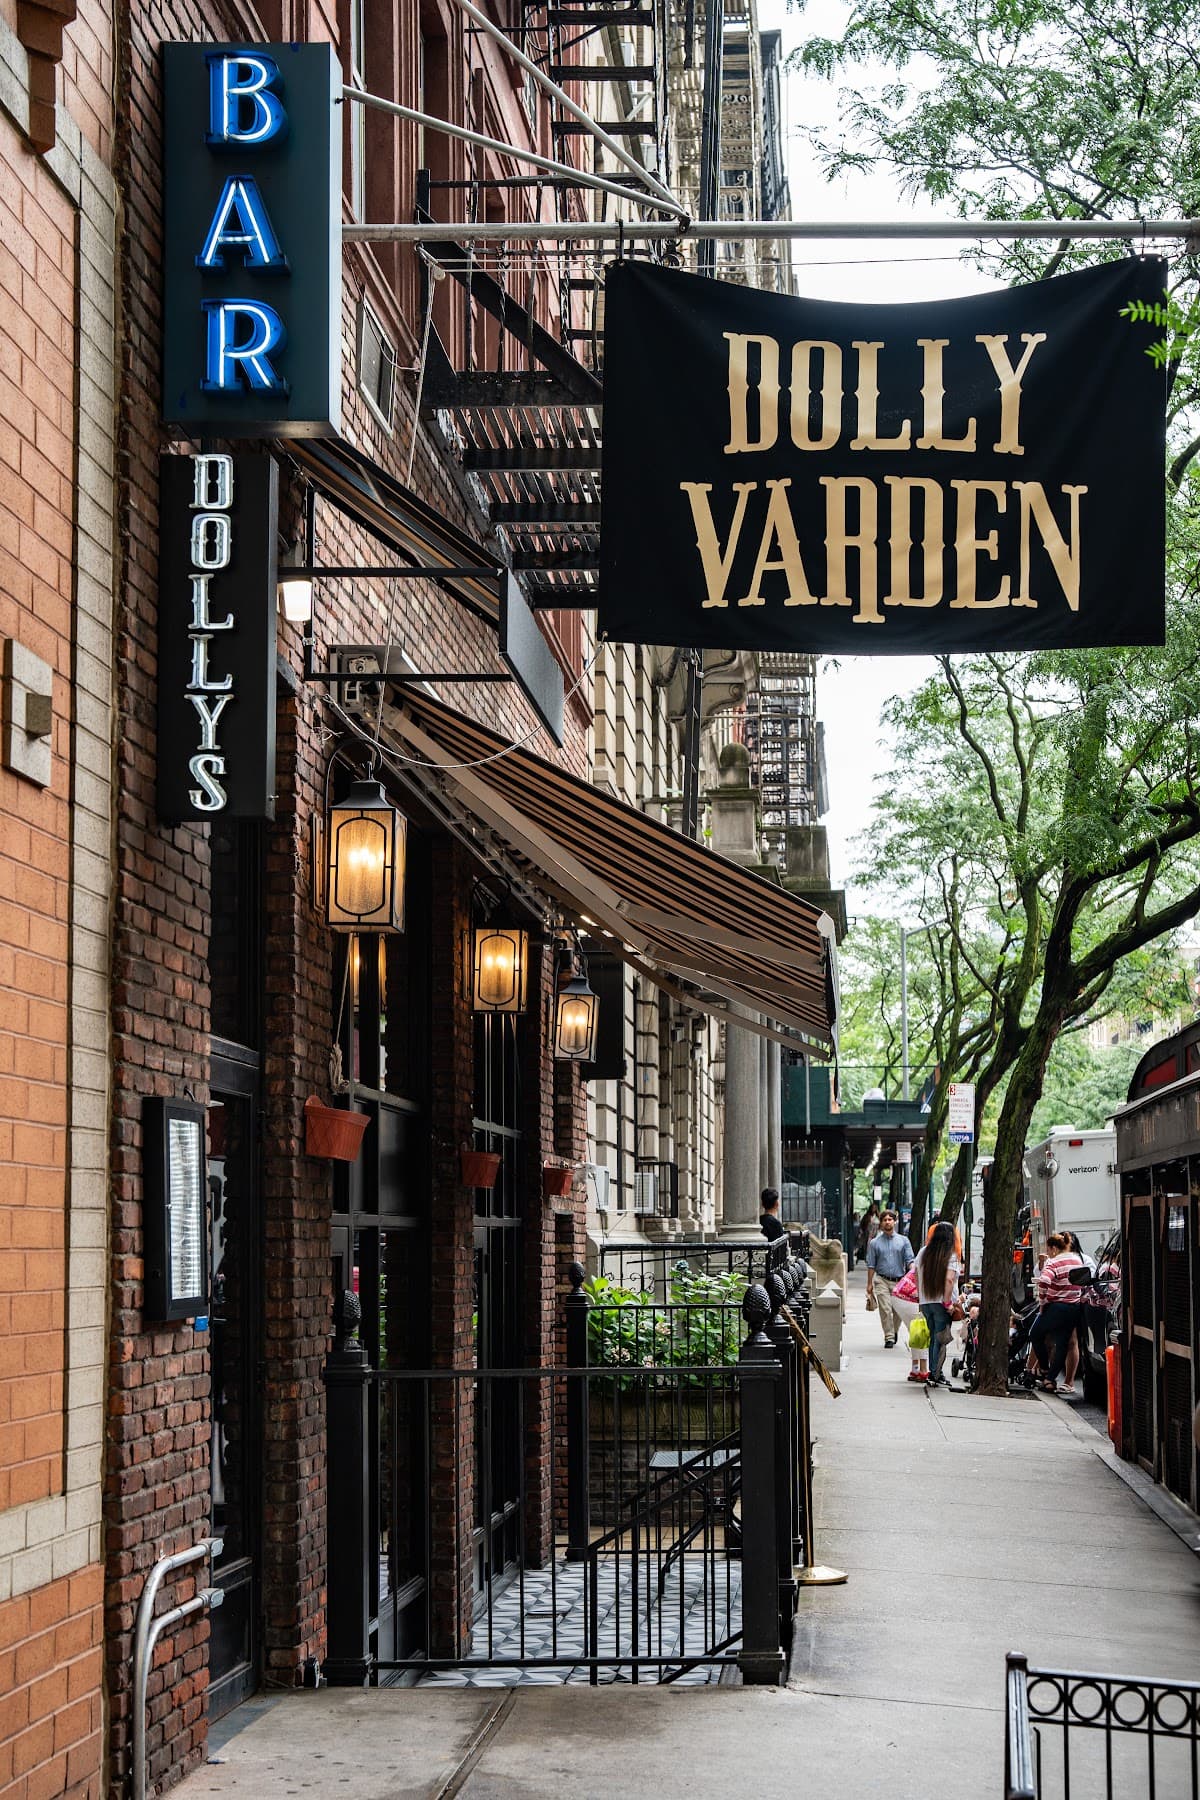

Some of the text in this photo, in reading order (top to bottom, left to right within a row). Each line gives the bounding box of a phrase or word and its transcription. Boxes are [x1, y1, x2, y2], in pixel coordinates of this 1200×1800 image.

[195, 51, 290, 397] BAR
[722, 331, 1047, 456] DOLLY
[680, 475, 1088, 624] VARDEN
[184, 454, 234, 811] DOLLYS
[1068, 1165, 1098, 1174] verizon
